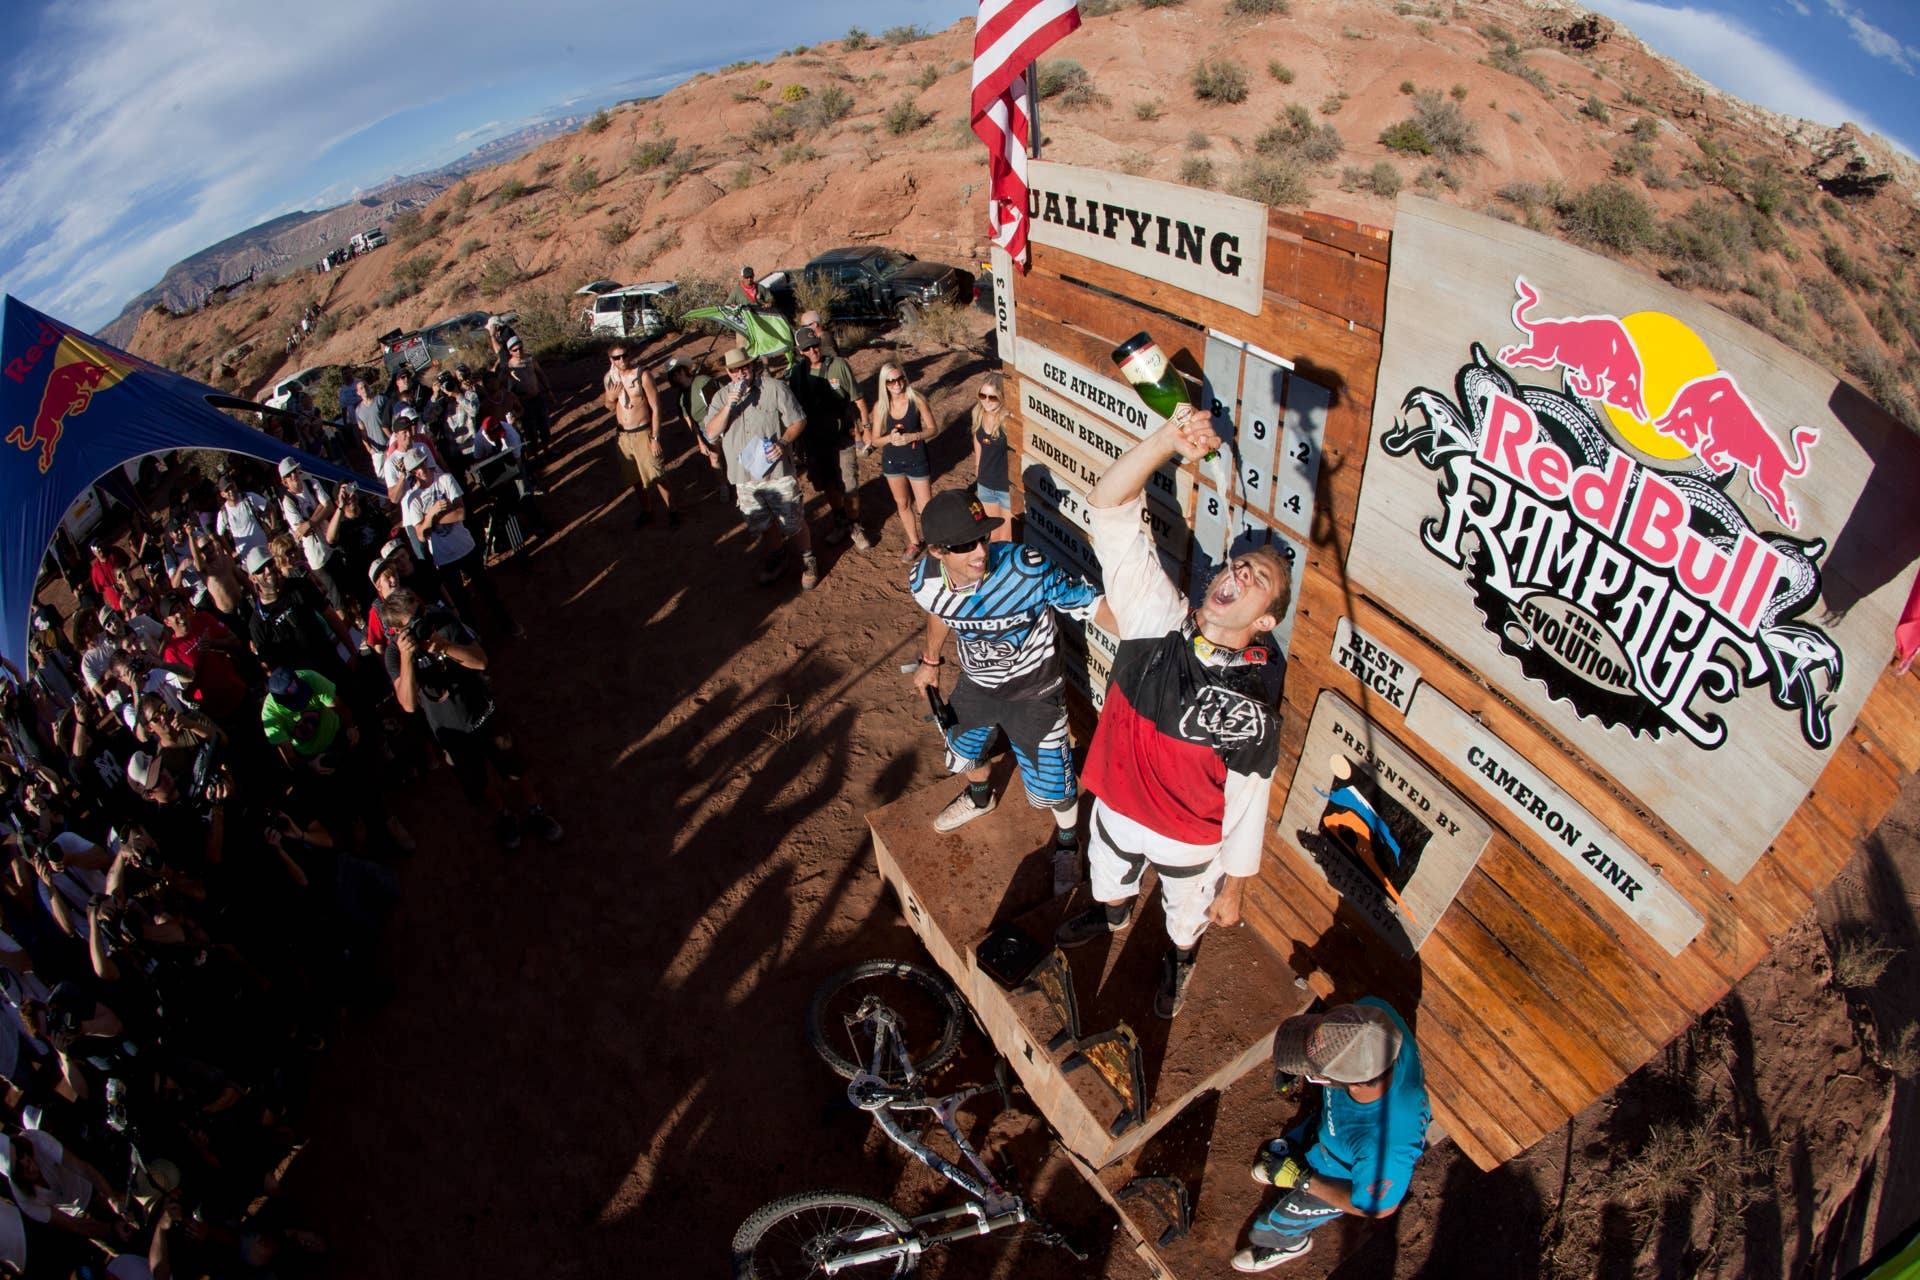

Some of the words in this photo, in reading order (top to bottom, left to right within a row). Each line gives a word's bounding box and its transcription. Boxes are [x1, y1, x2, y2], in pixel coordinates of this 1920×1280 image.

[1026, 188, 1242, 276] UALIFYING
[996, 278, 1006, 289] 3
[996, 296, 1008, 333] TOP
[1028, 395, 1075, 434] DARREN
[1043, 362, 1067, 388] GEE
[1070, 372, 1149, 430] ATHERTON
[1031, 434, 1077, 473] ANDREU
[1253, 420, 1266, 440] 9
[1039, 477, 1078, 515] GEOFF
[1246, 469, 1260, 489] 2
[1030, 507, 1079, 554] THOMAS
[1207, 498, 1219, 516] 8
[1476, 392, 1636, 537] Red
[1624, 470, 1784, 634] Bull
[1419, 455, 1769, 751] RAMPAGE
[1563, 609, 1604, 644] THE
[1349, 630, 1404, 682] BEST
[1523, 602, 1630, 689] EVOLUTION
[1339, 647, 1406, 709] TRICK
[1332, 722, 1431, 813] PRESENTED
[1436, 811, 1461, 838] BY
[1466, 745, 1583, 848] CAMERON
[1582, 841, 1644, 903] ZINK
